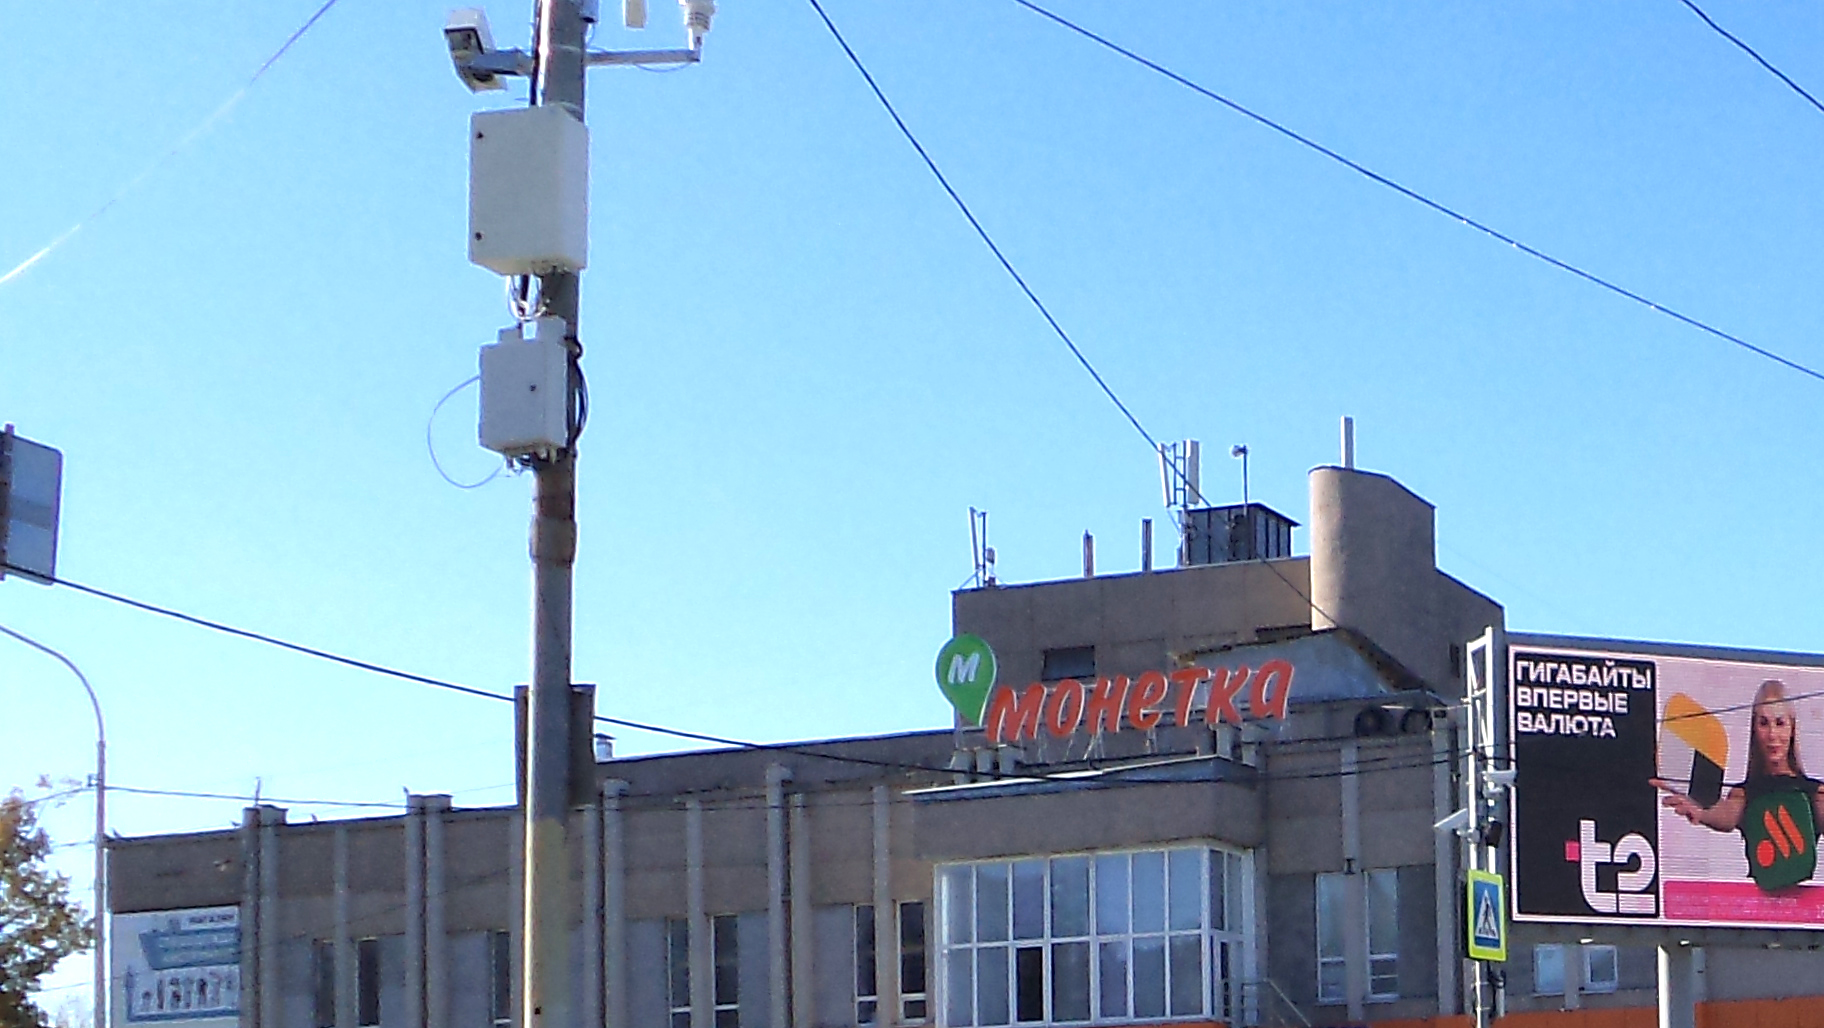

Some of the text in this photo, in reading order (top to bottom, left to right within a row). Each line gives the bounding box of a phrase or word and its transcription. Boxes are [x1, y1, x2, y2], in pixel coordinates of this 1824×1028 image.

[1516, 660, 1652, 690] ГИГАБАЙТЫ
[1516, 687, 1629, 714] ВПЕРВЫЕ
[1516, 712, 1617, 738] ВАЛЮТА
[1565, 819, 1656, 914] t2
